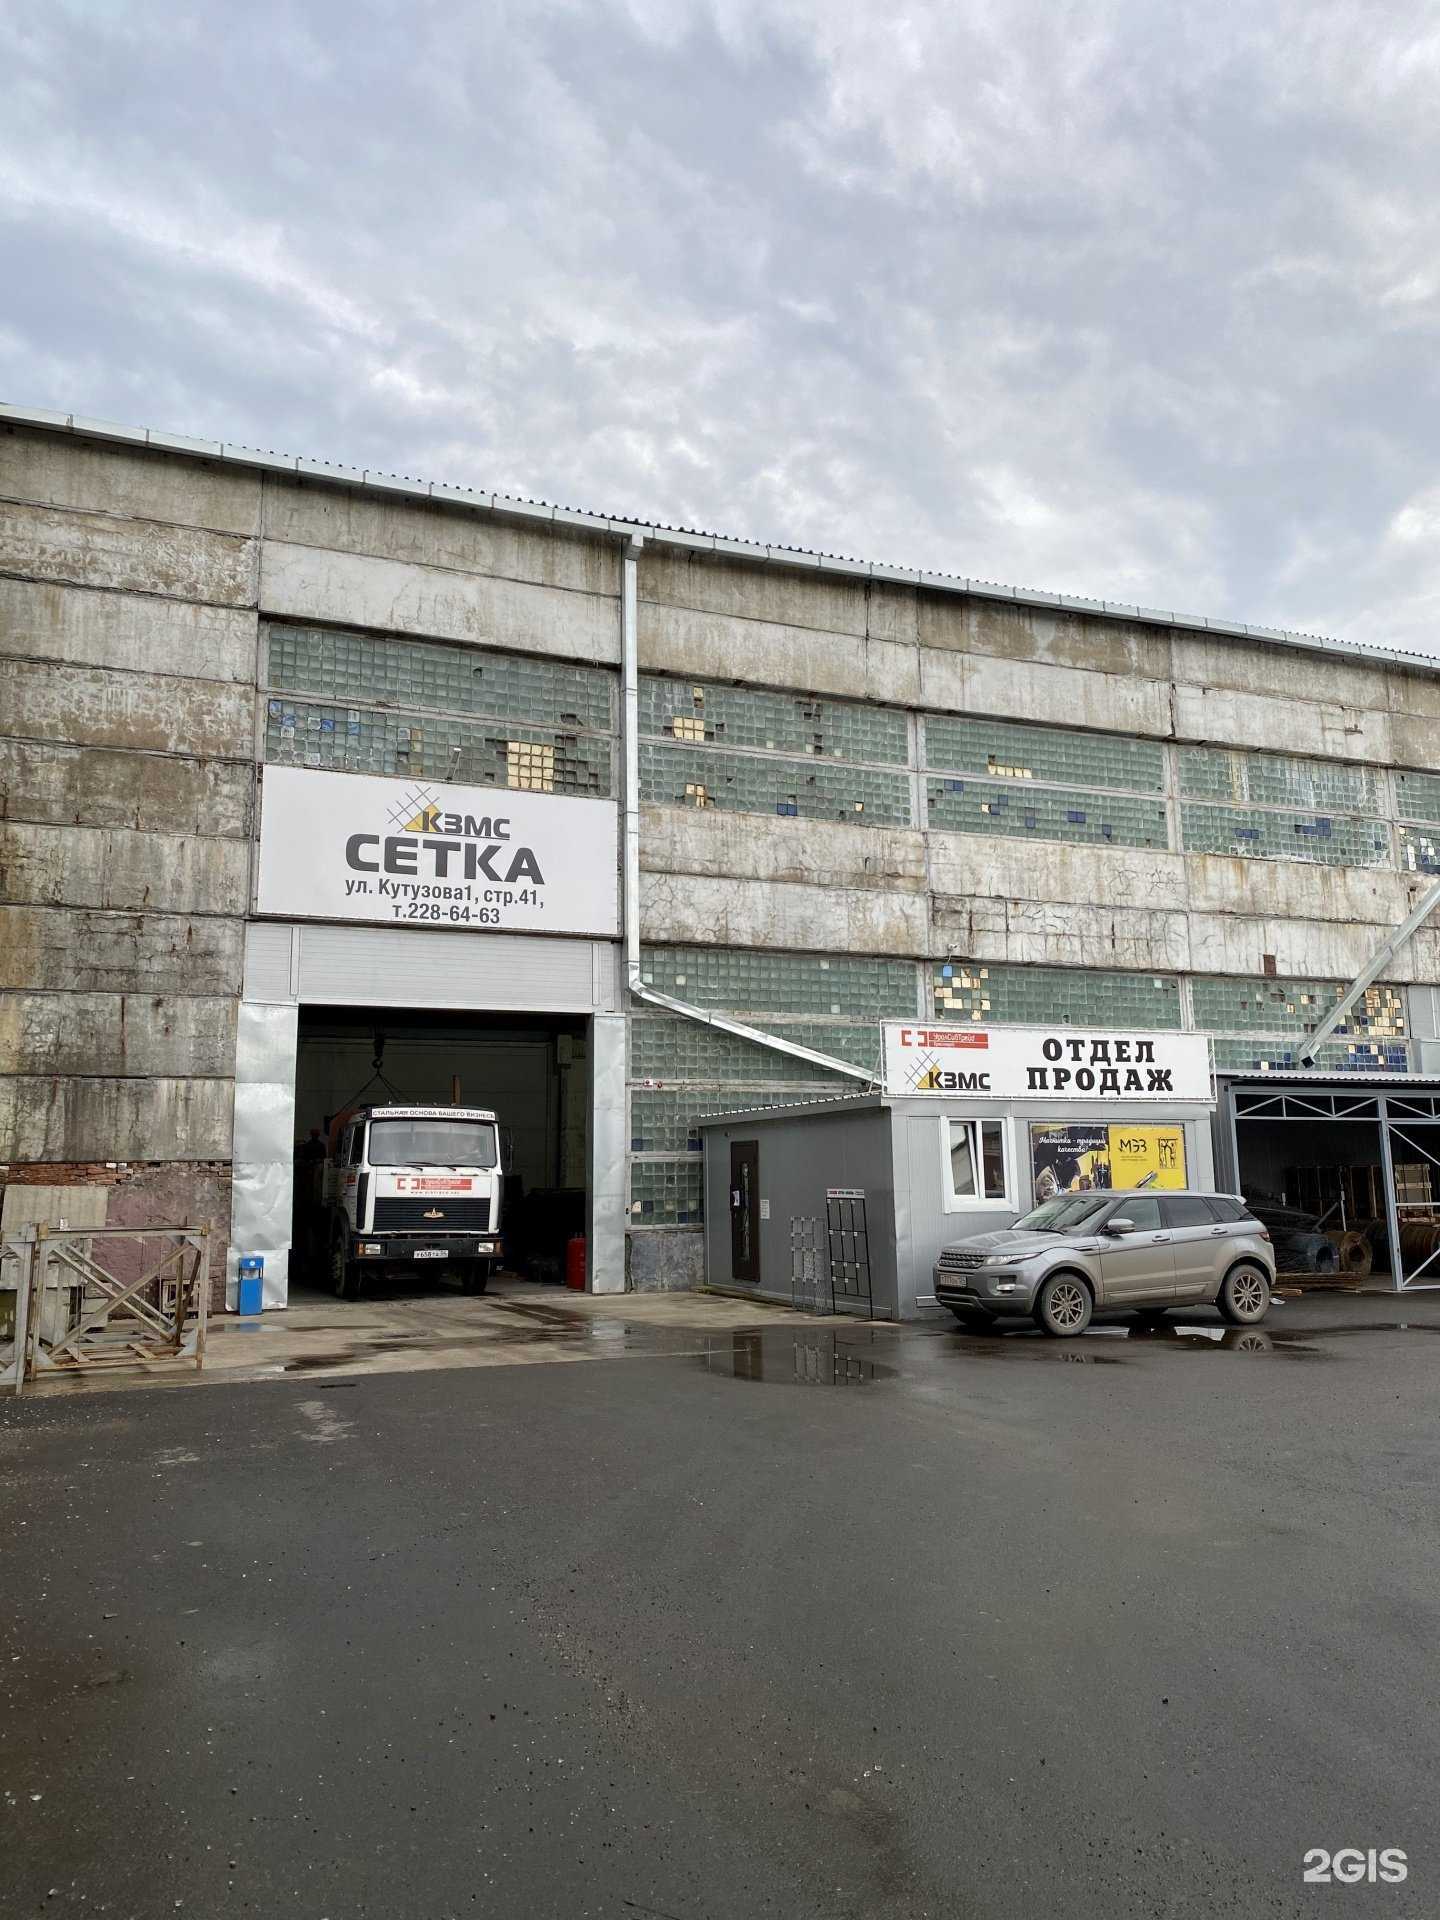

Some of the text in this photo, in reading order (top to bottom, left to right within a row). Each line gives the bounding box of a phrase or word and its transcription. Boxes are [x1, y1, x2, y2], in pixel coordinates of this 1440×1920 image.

[421, 810, 511, 838] КЗМС
[345, 833, 545, 885] СЕТКА
[345, 878, 545, 909] ул. Кутузова1, стр.41,
[391, 903, 501, 925] т.228-64-63
[1042, 1037, 1156, 1067] ОТДЕЛ
[927, 1070, 992, 1091] КЗМС
[1026, 1066, 1174, 1096] ПРОДАЖ
